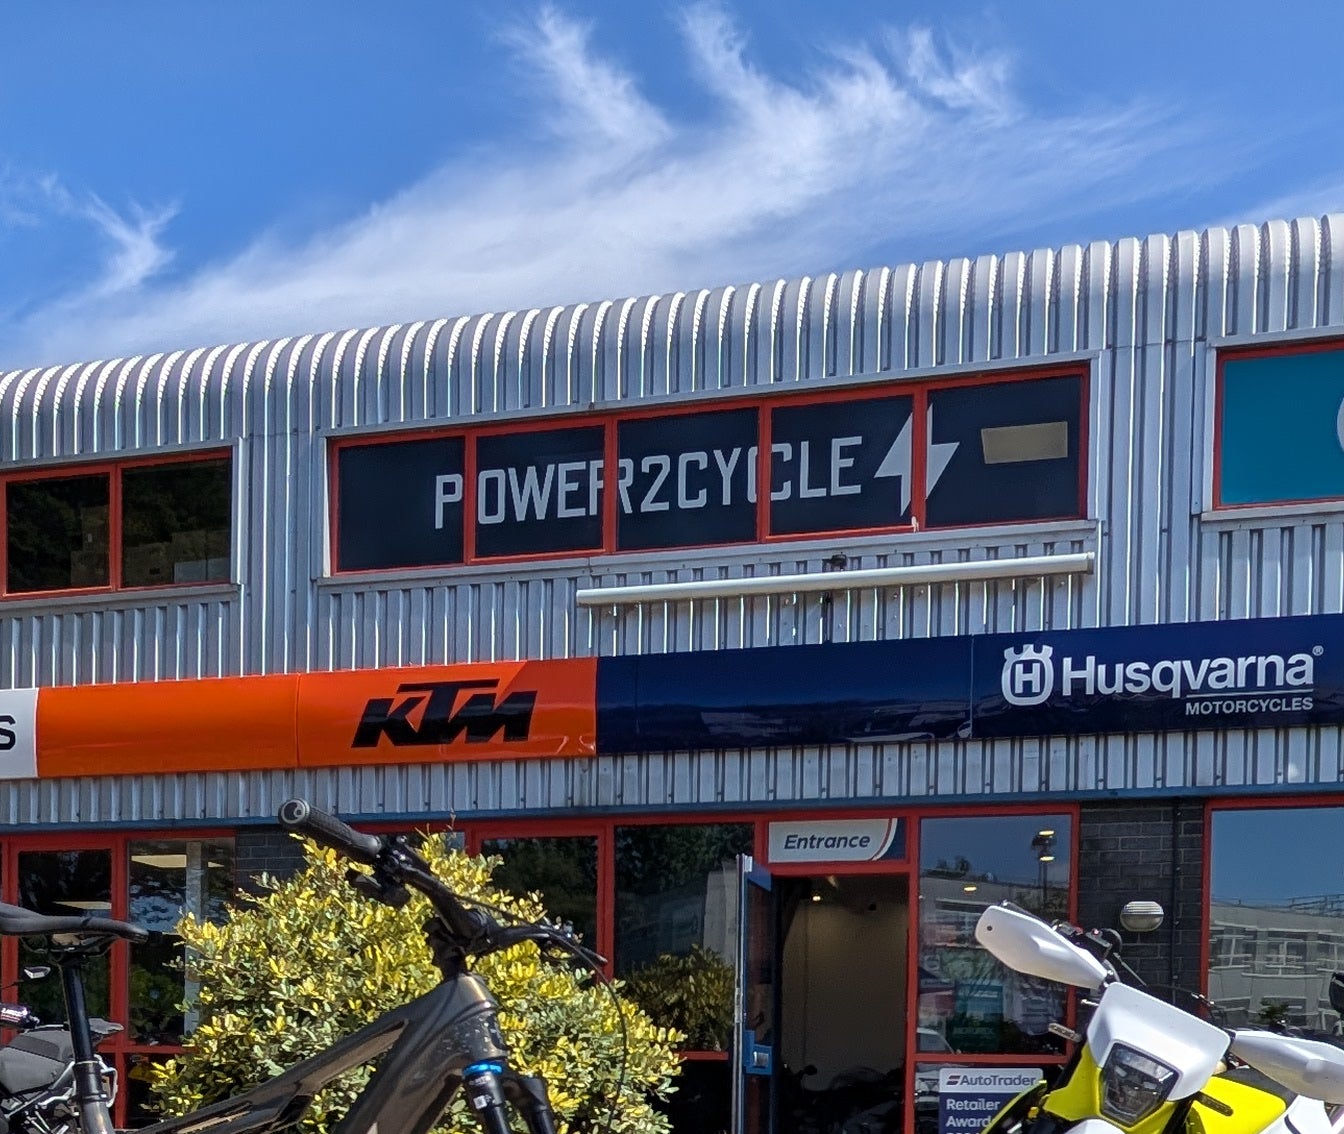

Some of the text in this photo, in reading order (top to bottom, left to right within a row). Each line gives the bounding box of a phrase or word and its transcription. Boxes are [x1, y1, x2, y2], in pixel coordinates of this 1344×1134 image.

[434, 436, 862, 529] POWER2CYCLE
[351, 678, 537, 749] KTM
[1185, 697, 1314, 716] MOTORCYCLES
[783, 833, 871, 850] Entrance
[946, 1098, 1000, 1110] Retailer
[946, 1116, 992, 1127] Award
